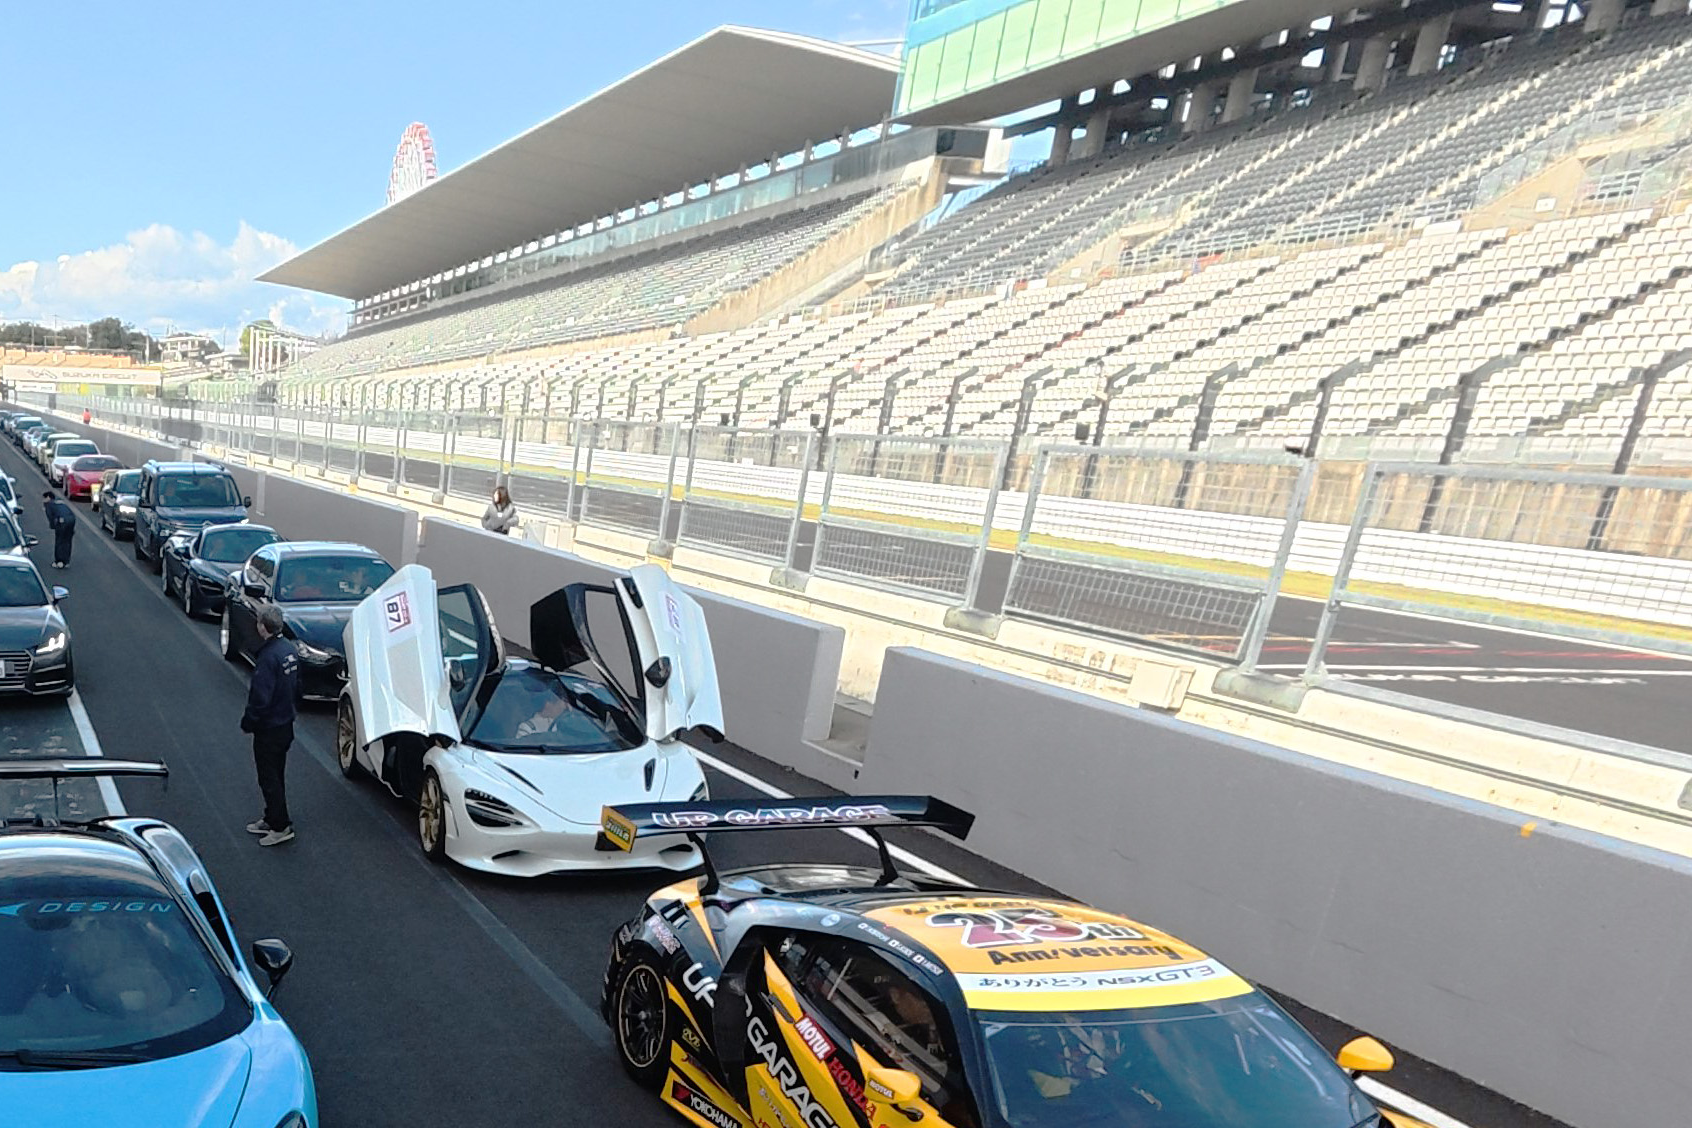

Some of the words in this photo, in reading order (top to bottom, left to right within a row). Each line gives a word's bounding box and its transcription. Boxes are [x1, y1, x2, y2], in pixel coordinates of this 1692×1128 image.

[387, 601, 402, 624] 87
[651, 810, 719, 828] UP
[723, 804, 897, 825] GARAGE
[38, 901, 177, 913] DESIGN
[978, 976, 1088, 988] ありがとう
[795, 1016, 832, 1060] MOTUL
[827, 1056, 877, 1121] HONDA
